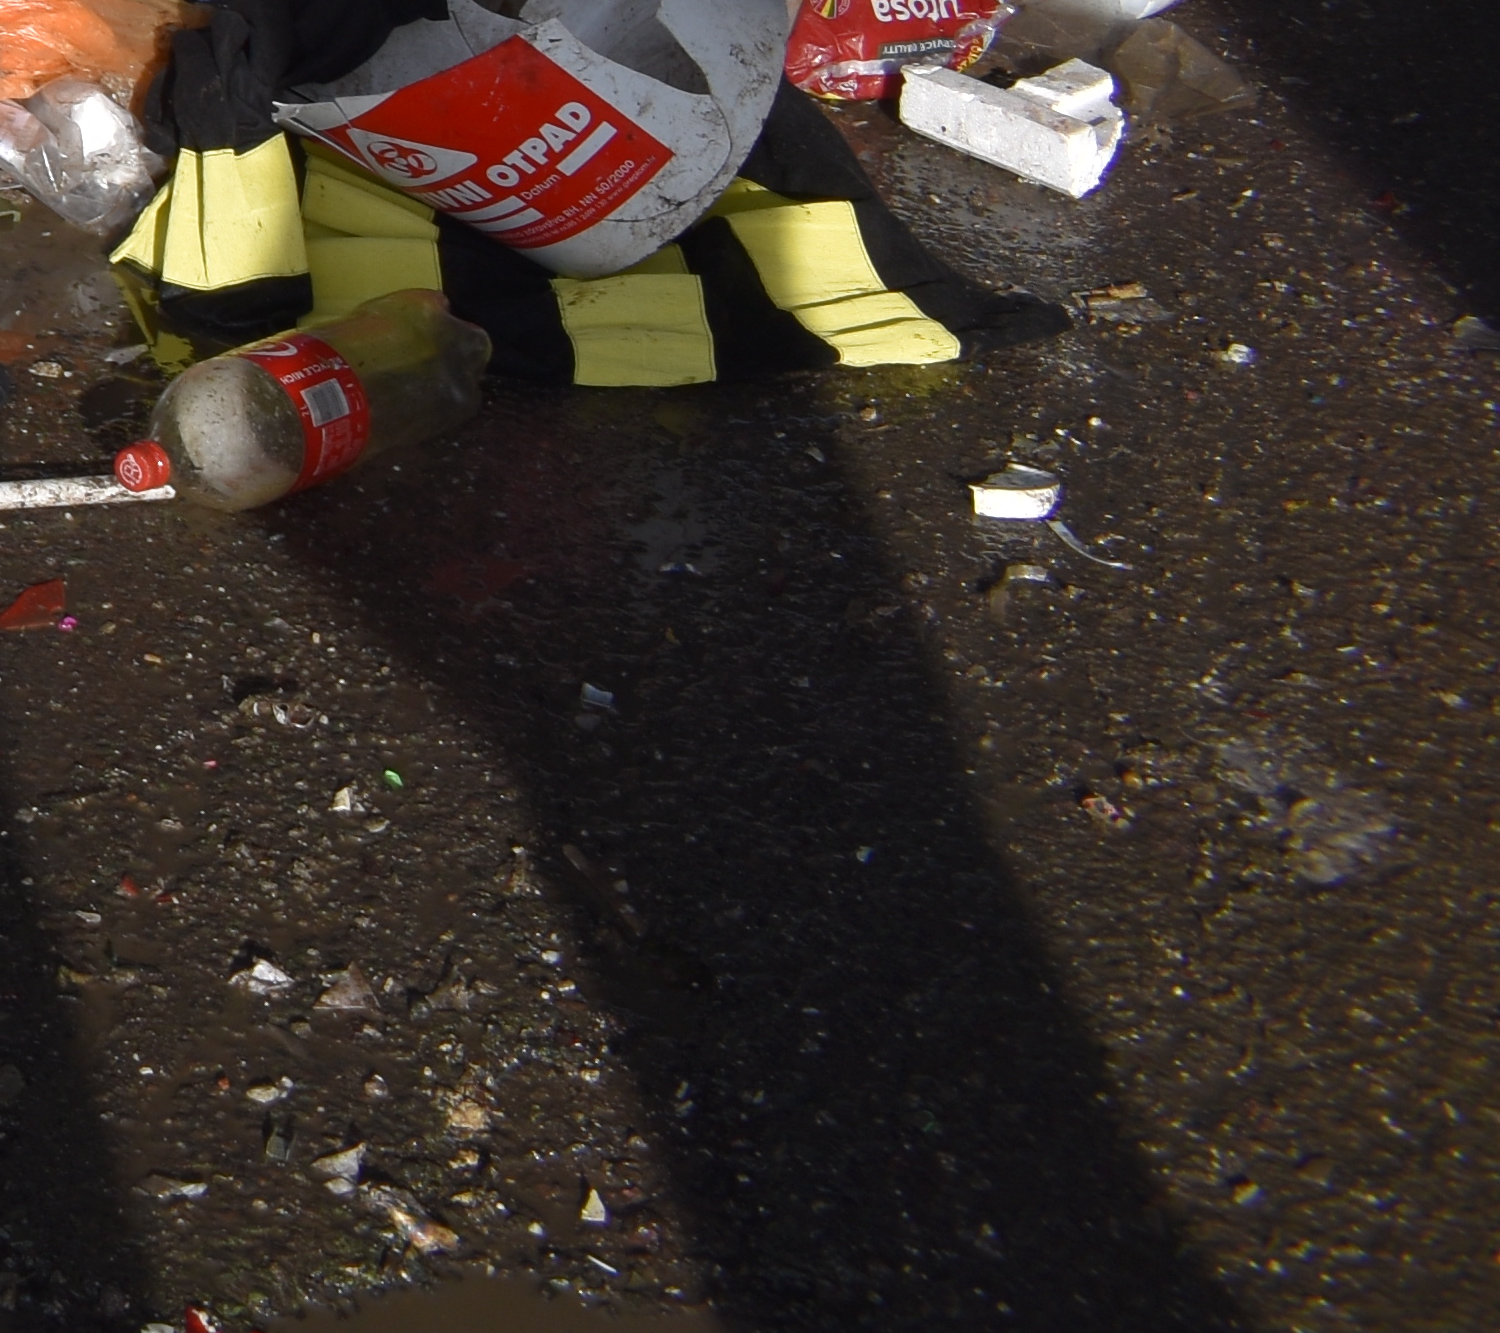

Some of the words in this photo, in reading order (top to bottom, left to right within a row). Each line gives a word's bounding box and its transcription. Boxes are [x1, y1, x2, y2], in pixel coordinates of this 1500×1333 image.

[486, 101, 592, 188] OTPAD
[520, 173, 562, 201] Datum
[597, 159, 636, 196] 50/2000
